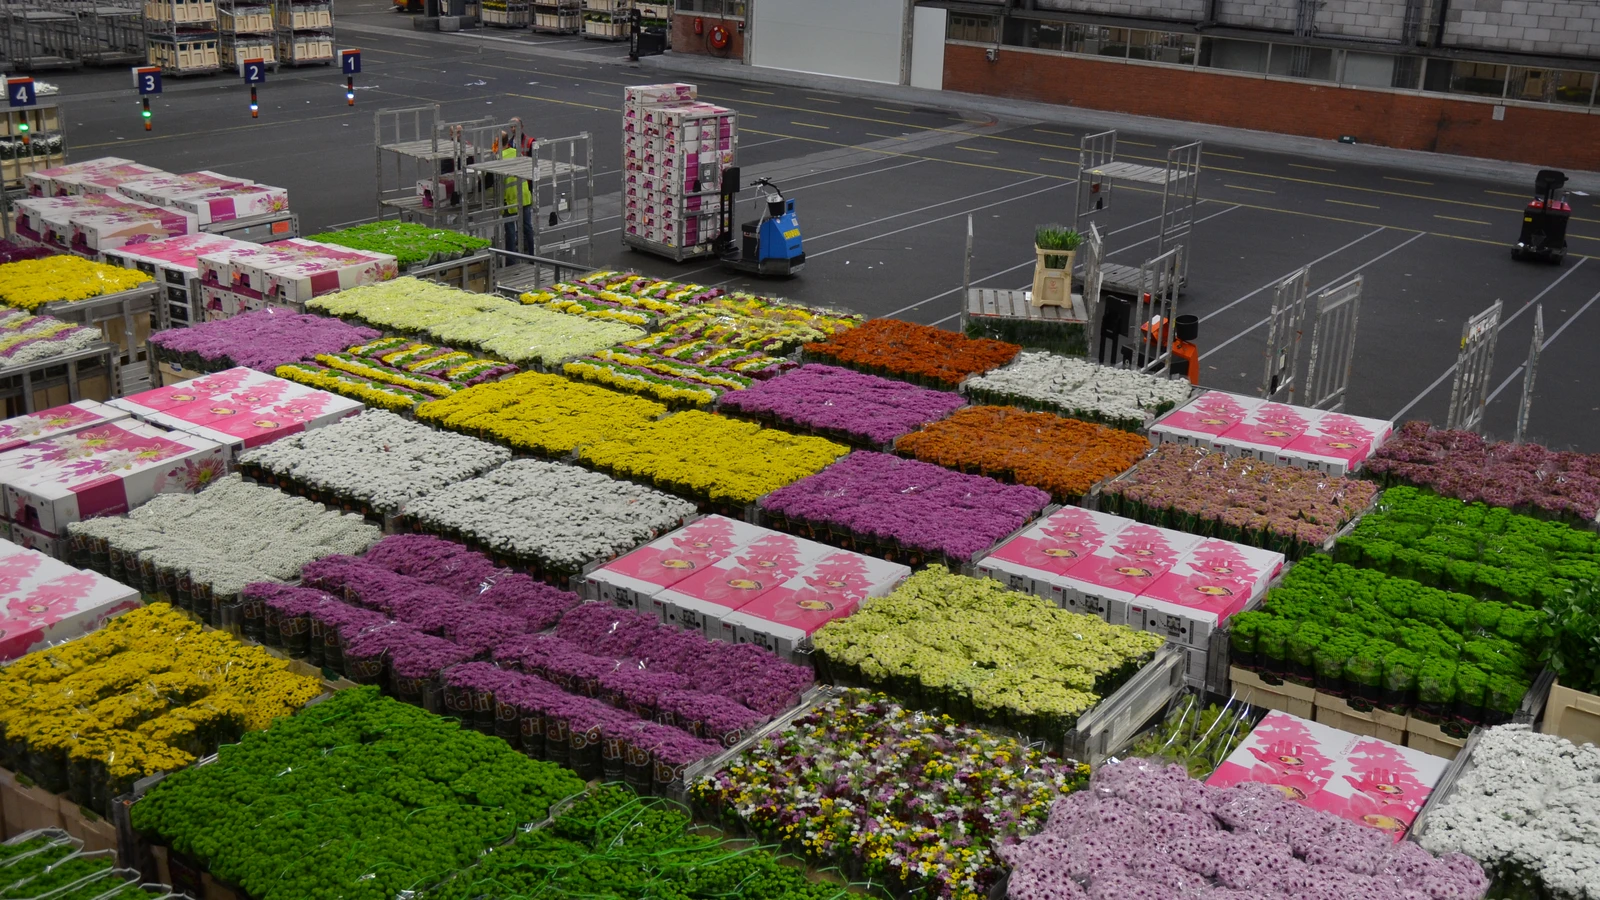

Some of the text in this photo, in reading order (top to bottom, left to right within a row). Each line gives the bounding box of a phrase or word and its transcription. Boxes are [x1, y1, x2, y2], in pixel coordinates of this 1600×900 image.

[347, 56, 355, 71] 1
[249, 65, 259, 81] 2
[144, 75, 155, 91] 3
[16, 86, 28, 103] 4
